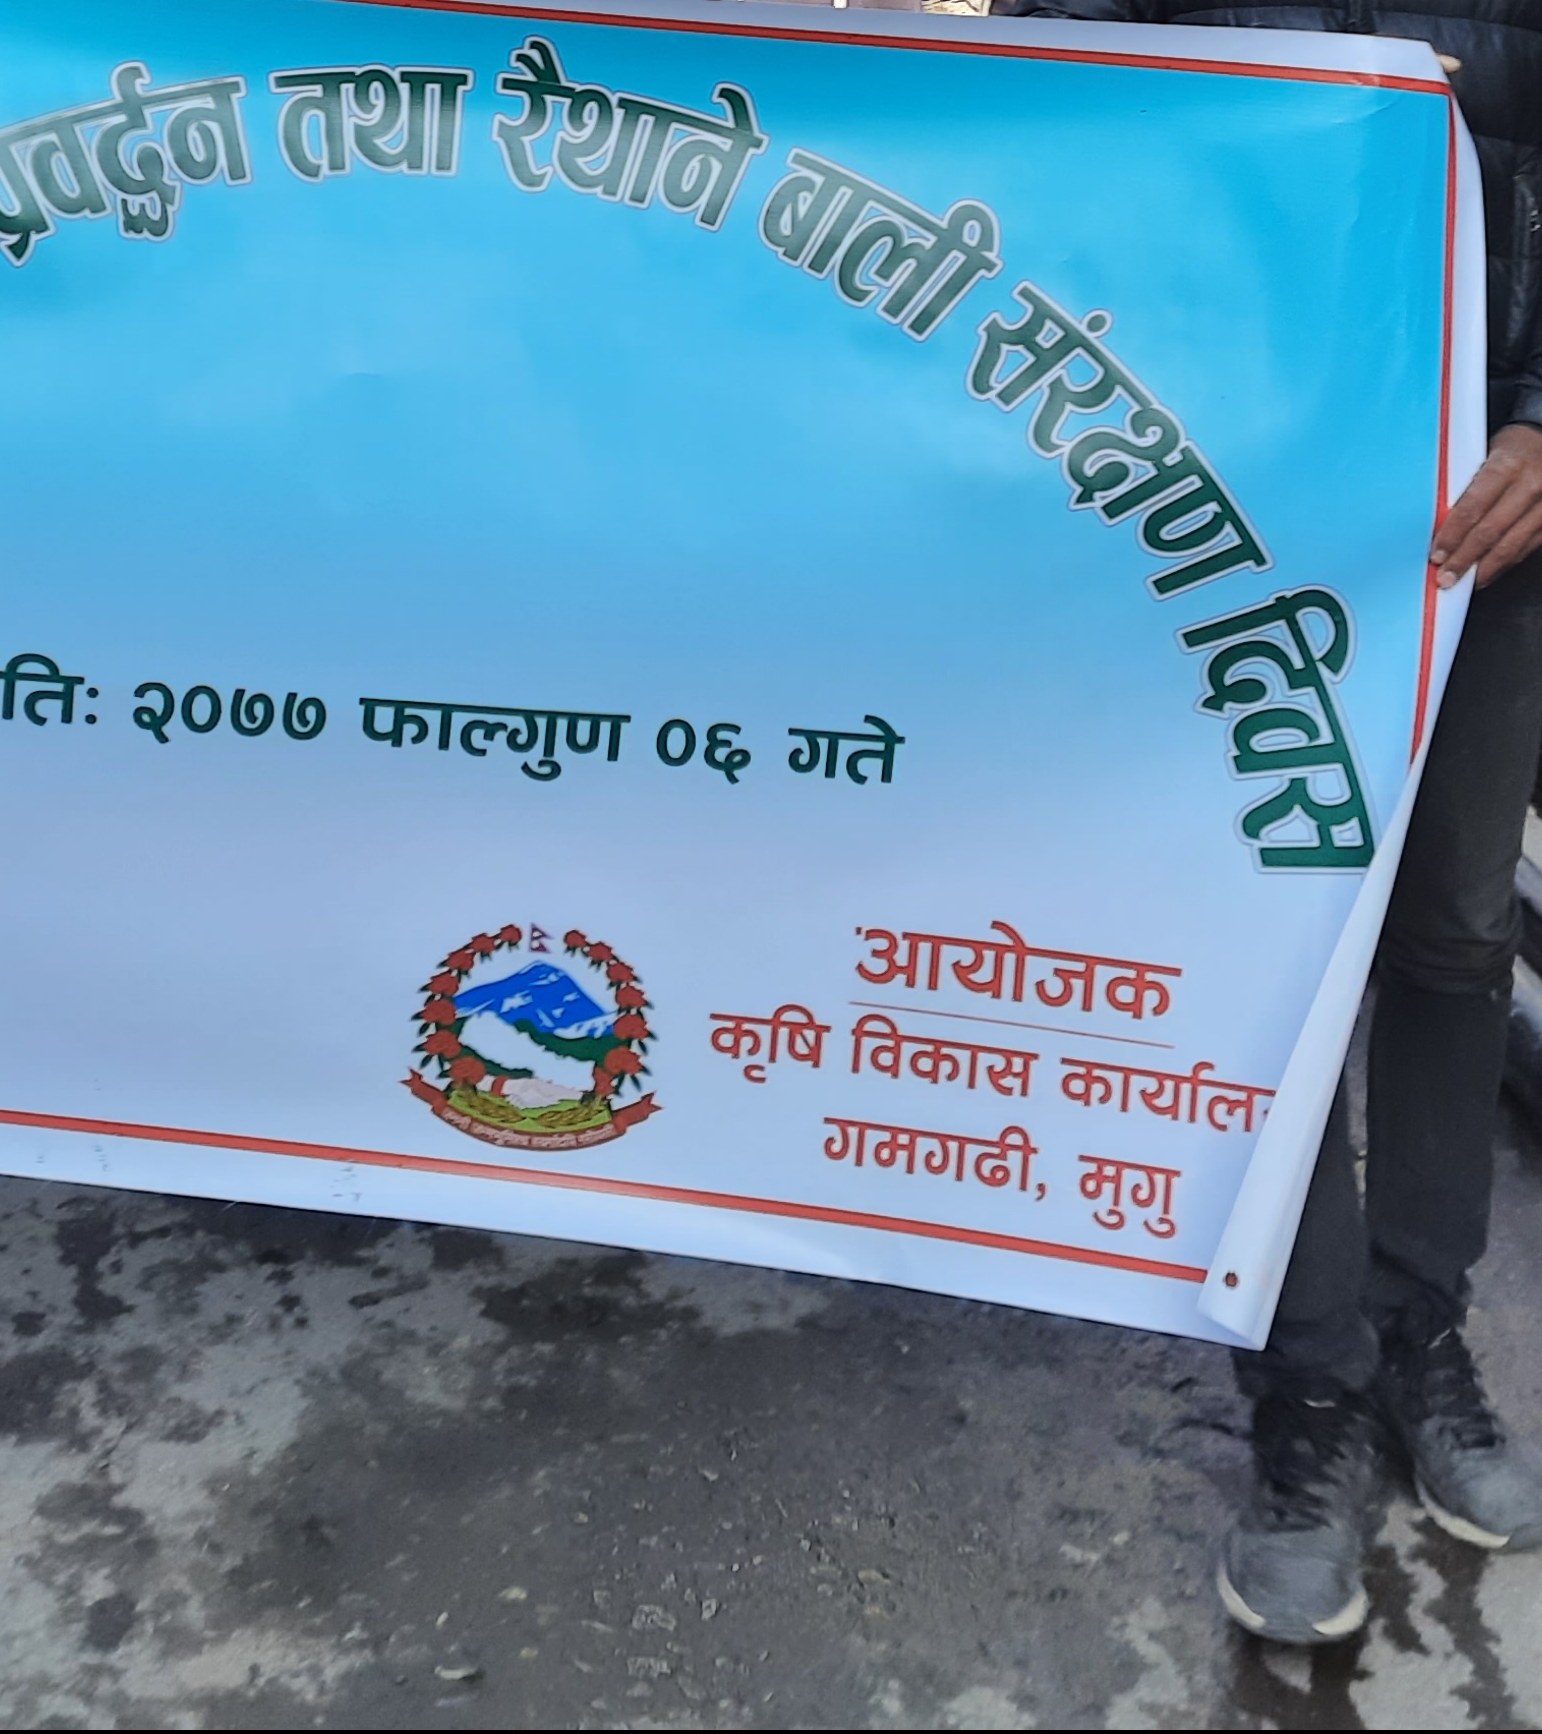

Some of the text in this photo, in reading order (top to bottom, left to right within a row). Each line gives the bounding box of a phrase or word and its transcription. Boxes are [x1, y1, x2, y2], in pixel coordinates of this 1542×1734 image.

[270, 66, 469, 182] तथा
[493, 37, 765, 229] रैथाने
[761, 149, 1001, 340] बाली
[969, 281, 1270, 601] संरक्षण
[1175, 584, 1377, 873] दिवस
[132, 681, 327, 744] २०७७
[361, 697, 630, 780] फाल्गुण
[655, 718, 751, 783] ०६
[789, 715, 905, 783] गते
[855, 921, 1182, 1020] आयोजक
[710, 1004, 1276, 1133] कृषि विकास कार्याल
[1077, 1154, 1181, 1238] मुगु
